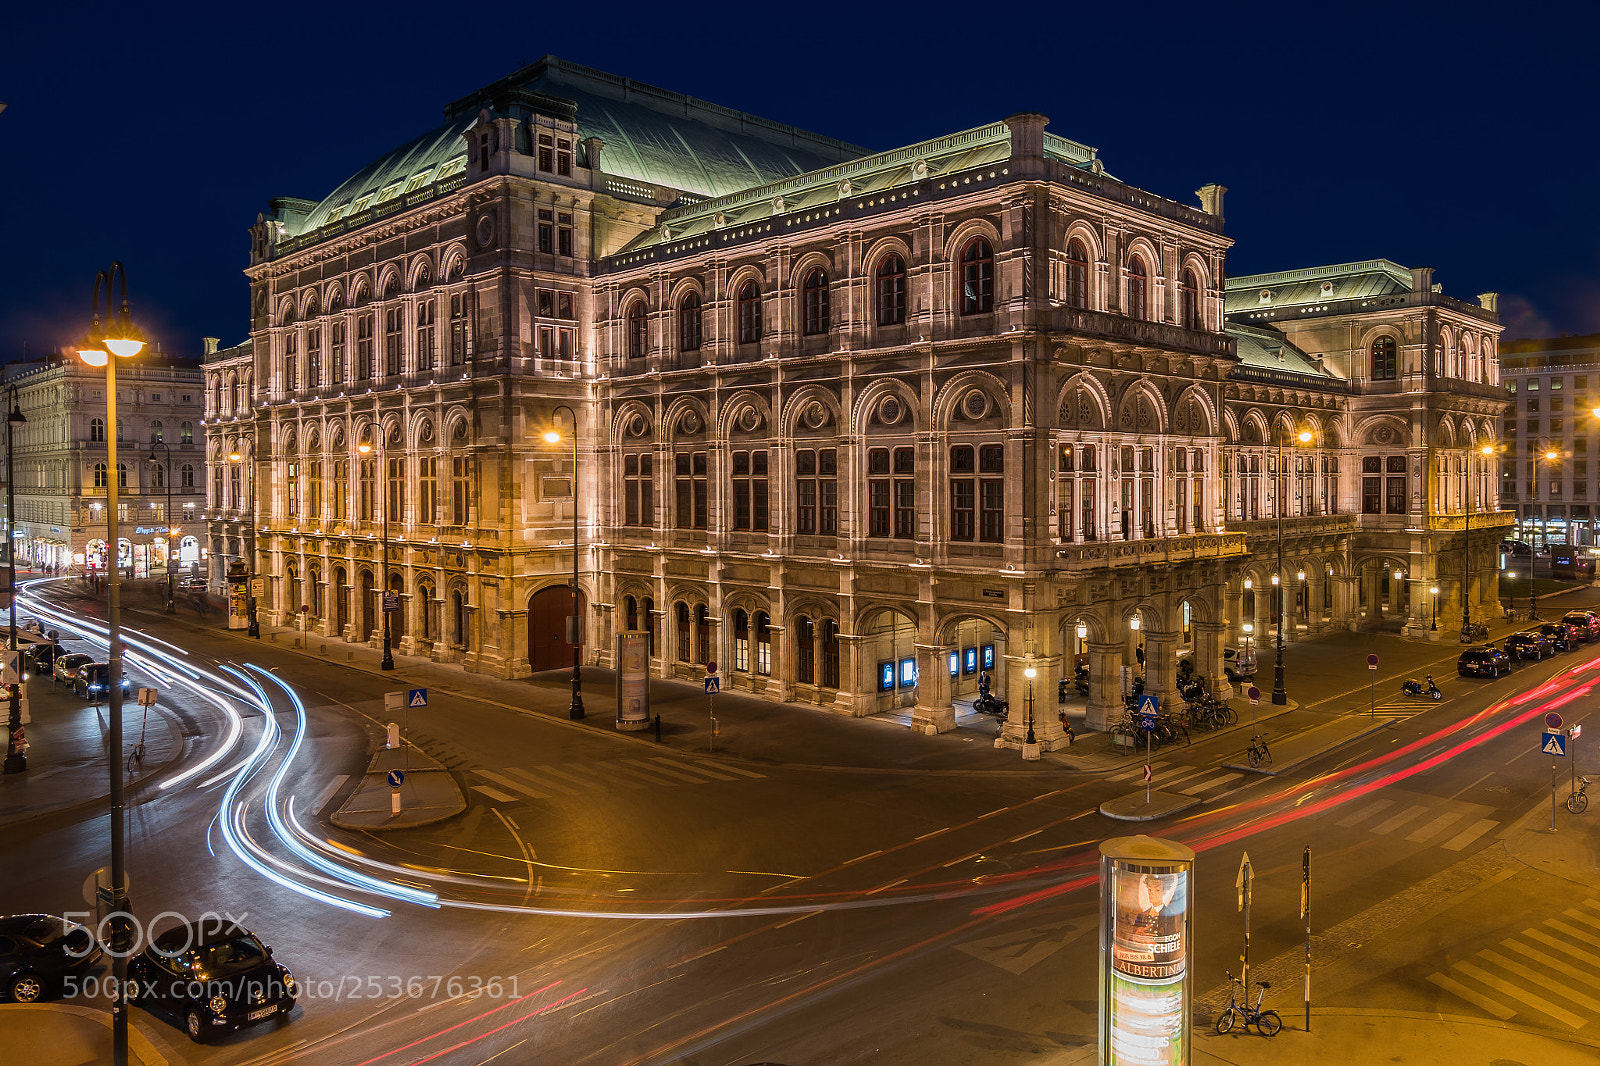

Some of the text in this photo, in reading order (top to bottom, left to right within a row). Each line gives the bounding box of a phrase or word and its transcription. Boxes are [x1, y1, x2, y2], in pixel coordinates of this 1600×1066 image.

[1165, 932, 1181, 943] EGON
[1148, 940, 1181, 954] SCHIELE
[1119, 960, 1181, 978] ALBERTINA
